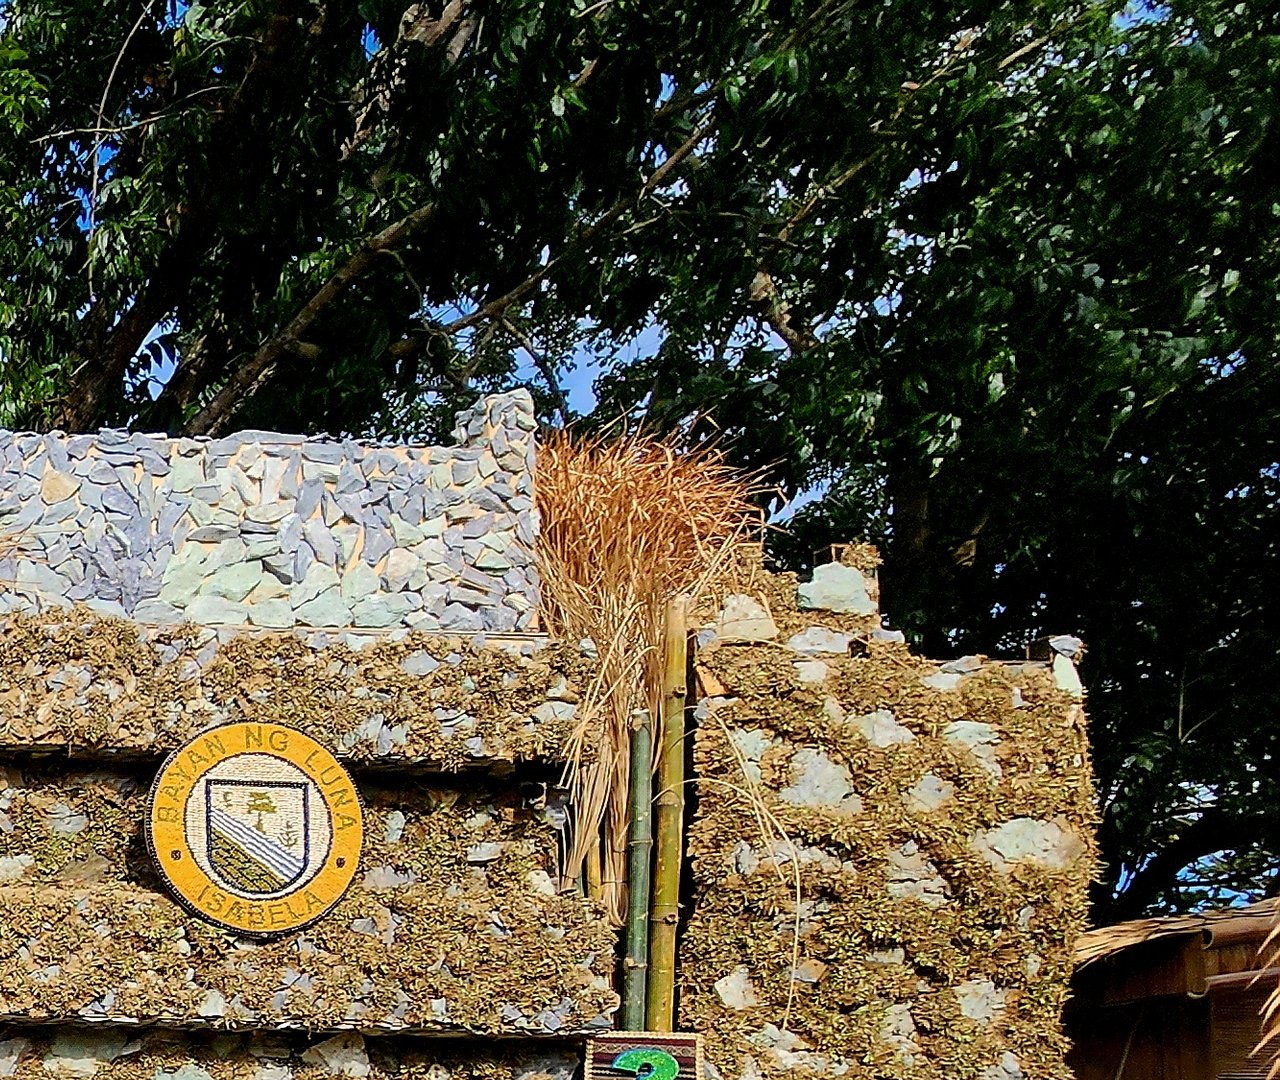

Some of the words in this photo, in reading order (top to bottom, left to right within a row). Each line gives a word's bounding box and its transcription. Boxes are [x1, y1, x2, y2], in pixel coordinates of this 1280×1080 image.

[156, 734, 226, 824] BAYAN
[245, 725, 288, 752] NG
[304, 750, 358, 831] LUNA
[197, 885, 325, 927] ISABELA
